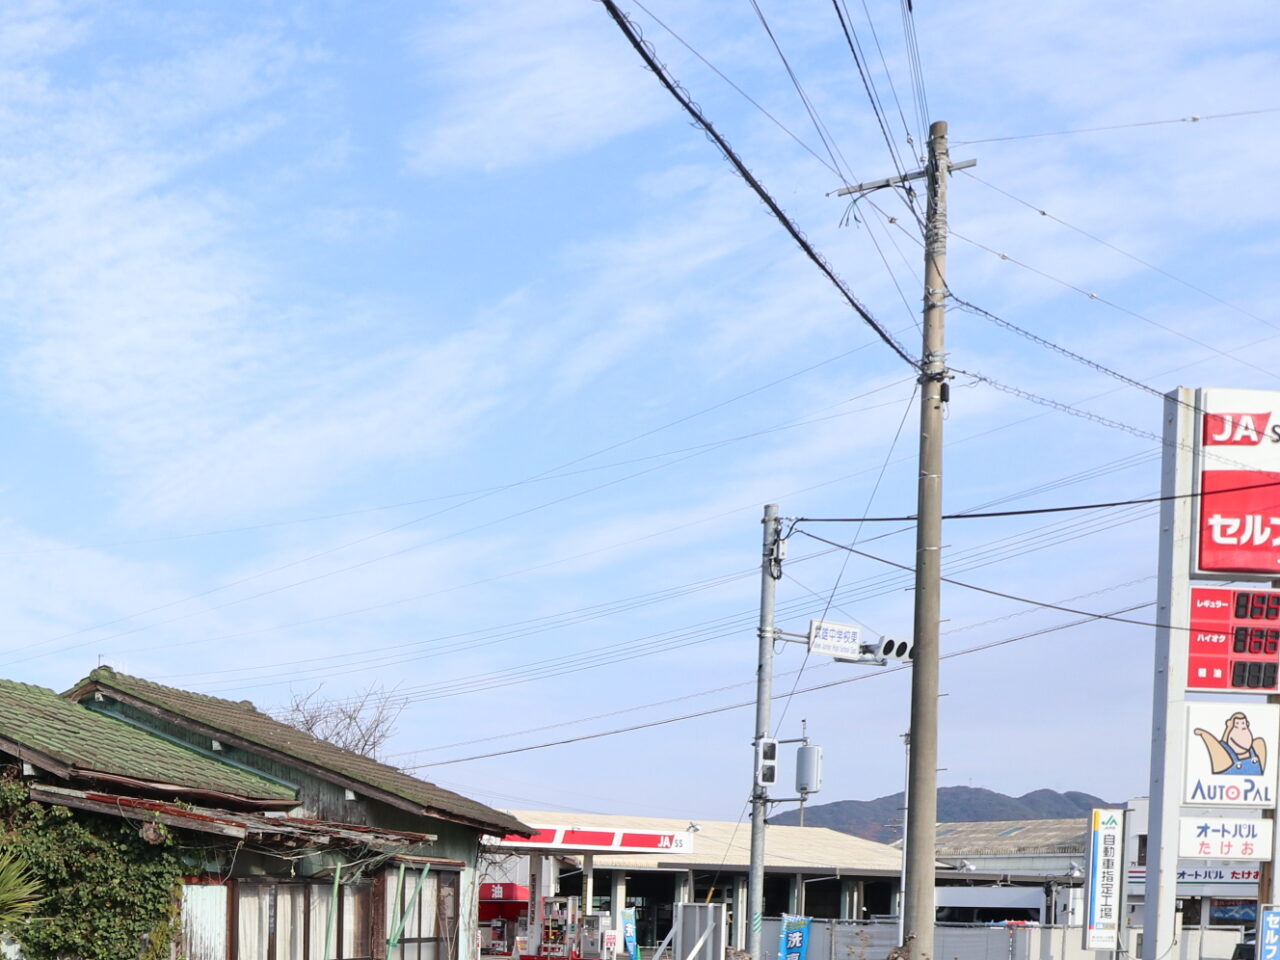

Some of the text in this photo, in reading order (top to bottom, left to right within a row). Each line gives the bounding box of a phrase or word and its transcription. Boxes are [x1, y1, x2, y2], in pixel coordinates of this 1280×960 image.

[1212, 414, 1259, 442] JA
[1196, 600, 1229, 608] レギュラー
[1197, 634, 1226, 643] ハイオク
[1196, 823, 1258, 839] オートパル
[657, 835, 671, 848] JA
[1198, 841, 1254, 856] たけお
[1100, 834, 1116, 919] 自動車指定工場
[491, 884, 504, 899] 油
